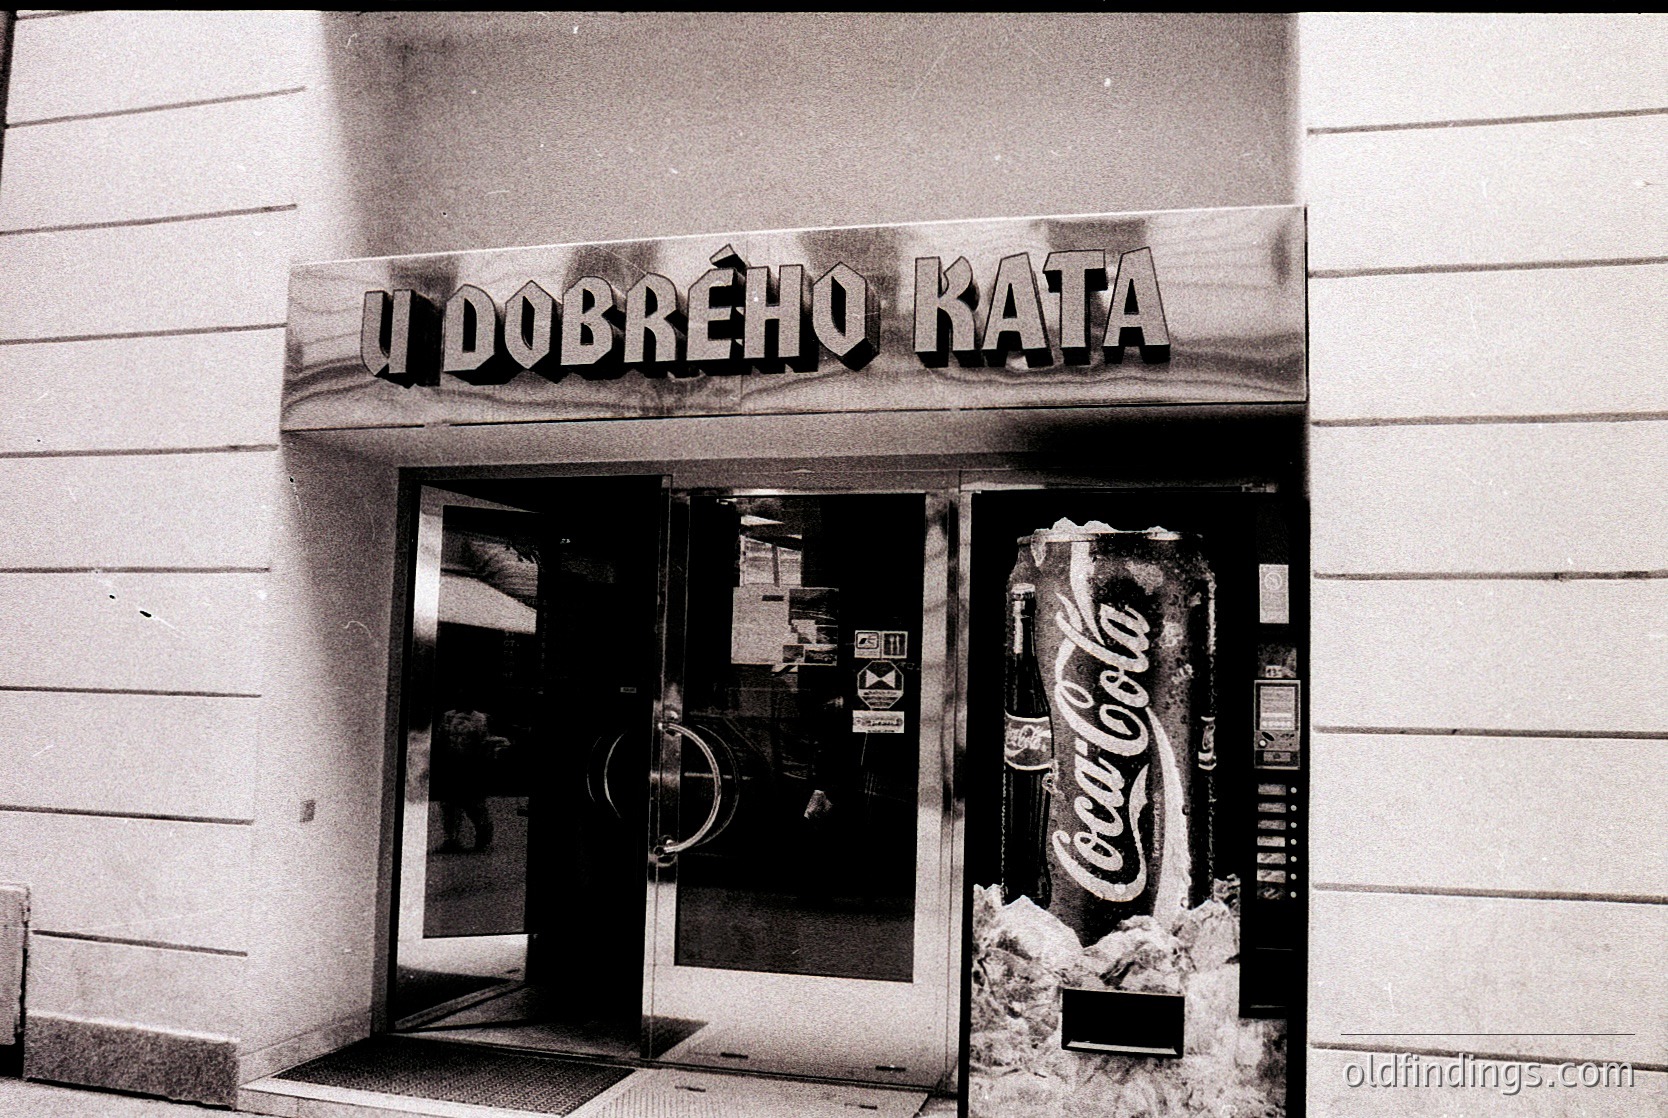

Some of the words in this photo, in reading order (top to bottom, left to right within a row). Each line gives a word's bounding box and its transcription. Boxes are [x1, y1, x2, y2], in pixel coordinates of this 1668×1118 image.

[360, 287, 430, 383] U
[443, 243, 874, 380] DOBRÉHO
[913, 246, 1171, 365] KATA
[1052, 592, 1150, 902] Coca-Cola
